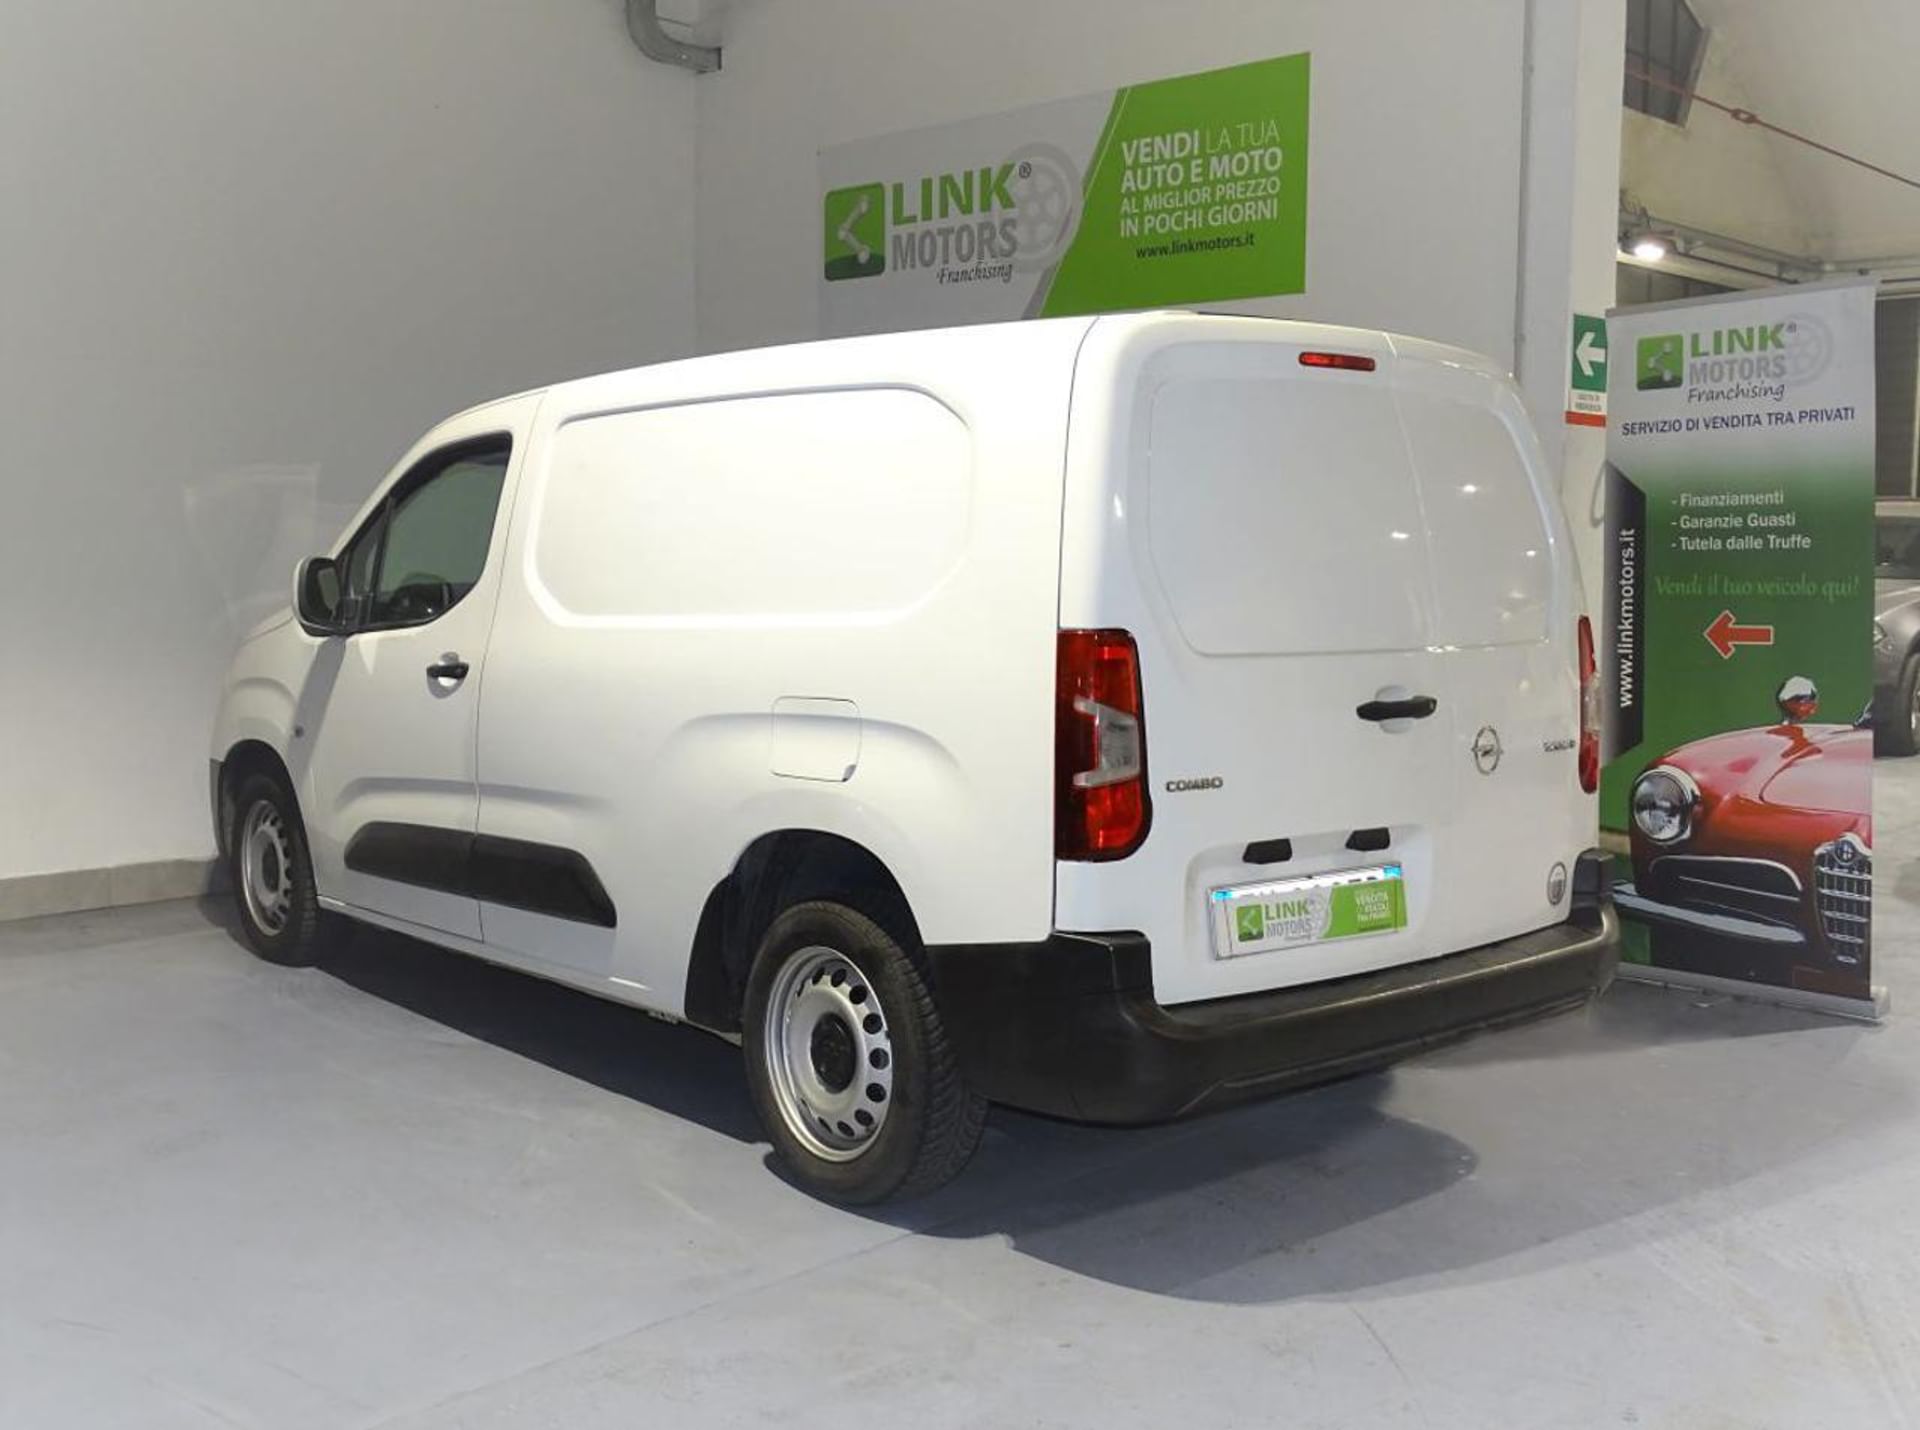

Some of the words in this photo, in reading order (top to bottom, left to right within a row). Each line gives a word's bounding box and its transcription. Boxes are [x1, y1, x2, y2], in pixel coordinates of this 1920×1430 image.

[1122, 129, 1199, 166] VENDI
[1206, 128, 1232, 154] LA
[1236, 120, 1280, 147] TUA
[1121, 162, 1184, 193] AUTO
[1190, 159, 1203, 183] E
[1209, 147, 1282, 180] MOTO
[1120, 197, 1138, 215] AL
[1143, 187, 1211, 212] MIGLIOR
[1216, 176, 1280, 203] PREZZO
[1120, 218, 1138, 238] IN
[1144, 208, 1202, 235] POCHI
[1208, 198, 1278, 226] GIORNI
[892, 218, 1018, 271] MOTORS
[1136, 232, 1254, 258] www.linkmotors.it
[938, 261, 1013, 284] Franchising
[1689, 354, 1786, 385] MOTORS
[1687, 380, 1785, 403] Franchising
[1622, 419, 1682, 436] SERVIZIO
[1686, 417, 1699, 431] DI
[1703, 413, 1762, 431] VENDITA
[1766, 411, 1796, 426] TRA
[1799, 407, 1855, 424] PRIVATI
[1680, 490, 1784, 507] Finanziamenti
[1680, 513, 1743, 529] Garanzie
[1747, 511, 1796, 527] Guasti
[1680, 536, 1722, 551] Tutela
[1726, 535, 1763, 550] dalle
[1767, 534, 1811, 550] Truffe
[1655, 573, 1702, 596] Vendi
[1723, 575, 1750, 596] tuo
[1757, 572, 1816, 596] veicolo
[1617, 528, 1635, 708] www.linkmotors.it
[1166, 776, 1224, 793] COMBO
